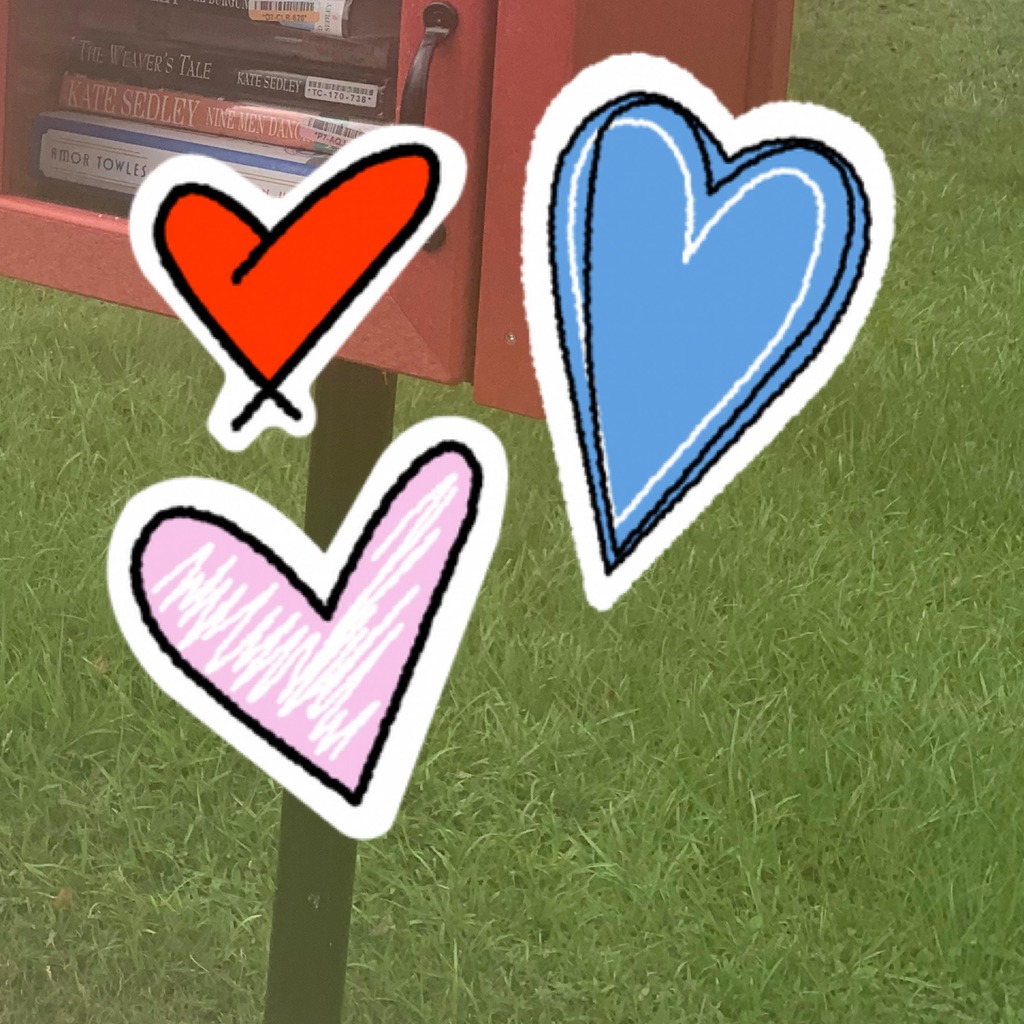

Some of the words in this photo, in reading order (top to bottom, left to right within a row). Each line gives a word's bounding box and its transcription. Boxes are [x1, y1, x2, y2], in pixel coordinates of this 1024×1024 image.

[79, 39, 103, 64] THE
[109, 43, 174, 74] WEAVER'S
[179, 53, 213, 80] TALE
[236, 70, 261, 89] KATE
[264, 75, 303, 94] SEDLEY
[66, 78, 114, 113] KATE
[121, 87, 201, 127] SEDLEY
[206, 107, 235, 130] NINE
[238, 111, 266, 134] MEN
[50, 146, 90, 166] AMOR
[96, 155, 147, 178] TOWLES
